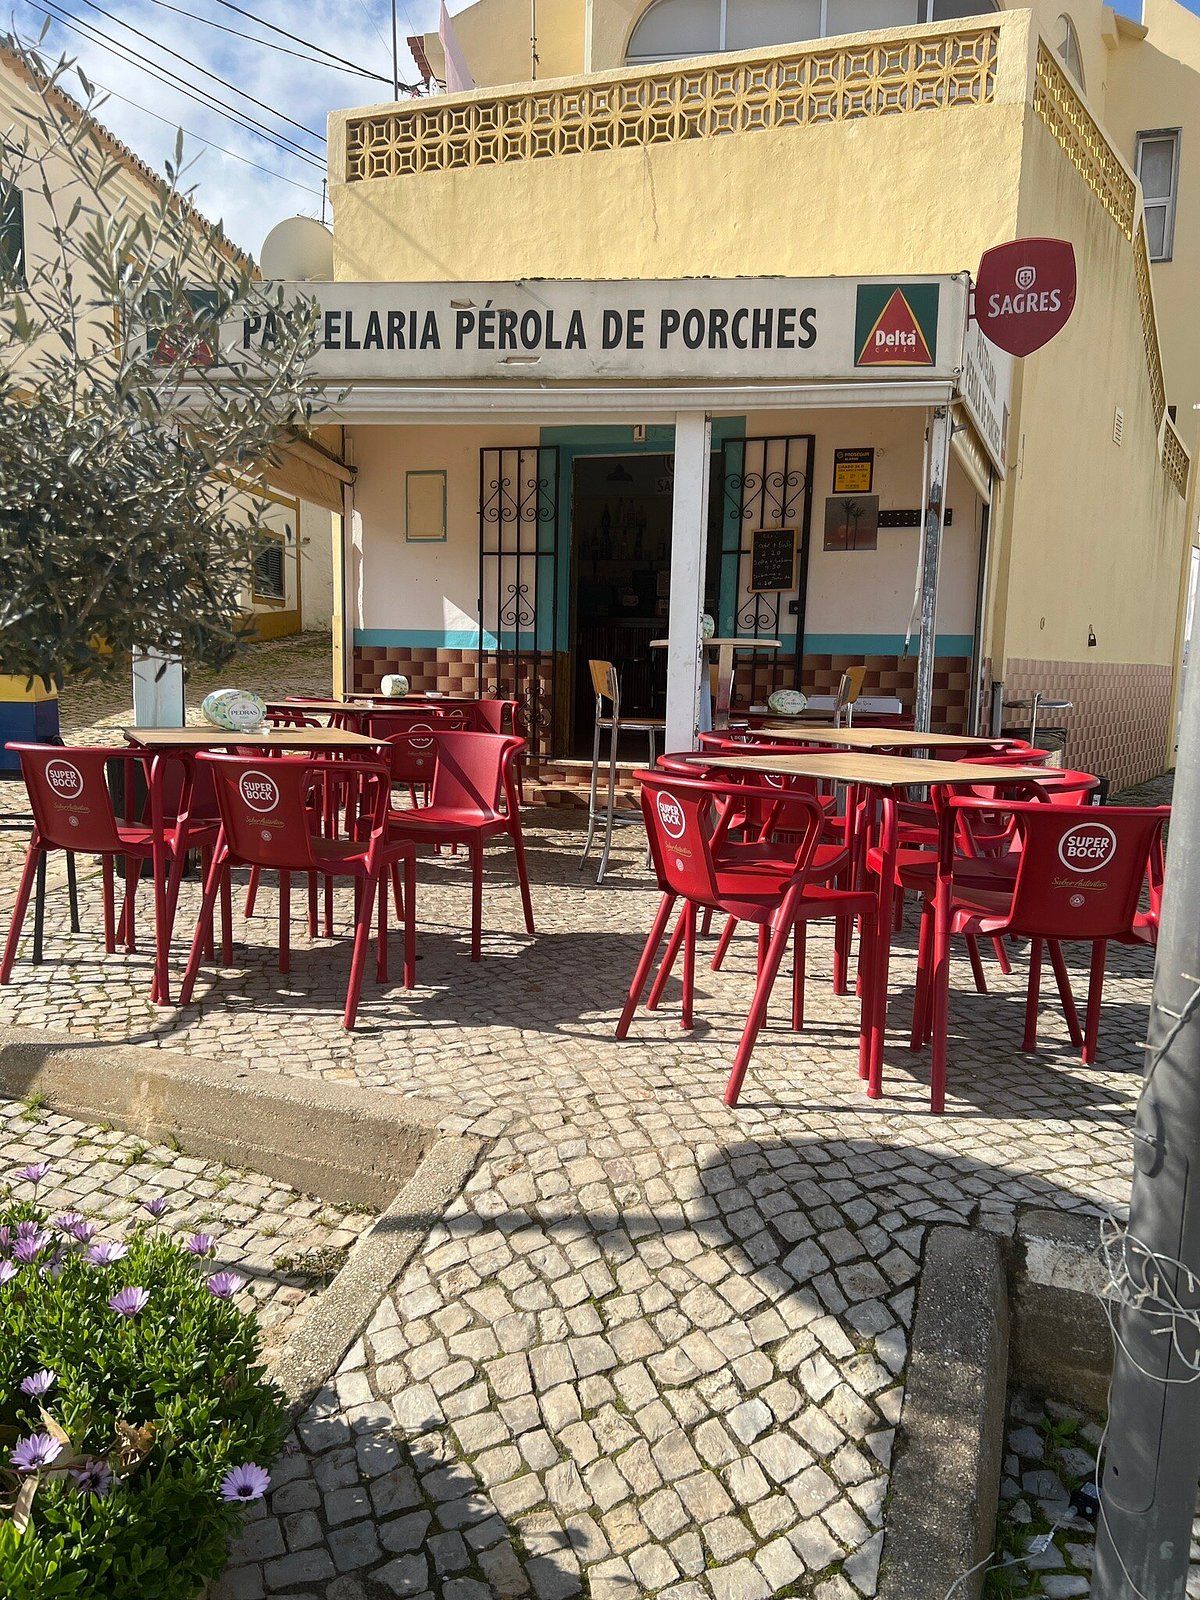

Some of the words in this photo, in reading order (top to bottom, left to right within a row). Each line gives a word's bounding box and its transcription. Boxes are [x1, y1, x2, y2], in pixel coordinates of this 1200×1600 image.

[988, 289, 1061, 318] SAGRES
[243, 310, 441, 350] PAELARIA
[455, 300, 587, 350] PÉROLA
[602, 309, 645, 350] DE
[660, 307, 818, 350] PORCHES
[875, 329, 916, 346] Delta
[657, 479, 673, 493] SA
[48, 769, 77, 780] SUPER
[52, 778, 78, 788] BOCK
[243, 781, 273, 792] SUPER
[246, 790, 273, 801] BOCK
[659, 802, 680, 816] SUPER
[662, 812, 681, 826] BOCK
[1067, 836, 1110, 848] SUPER
[1067, 846, 1106, 858] BOCK
